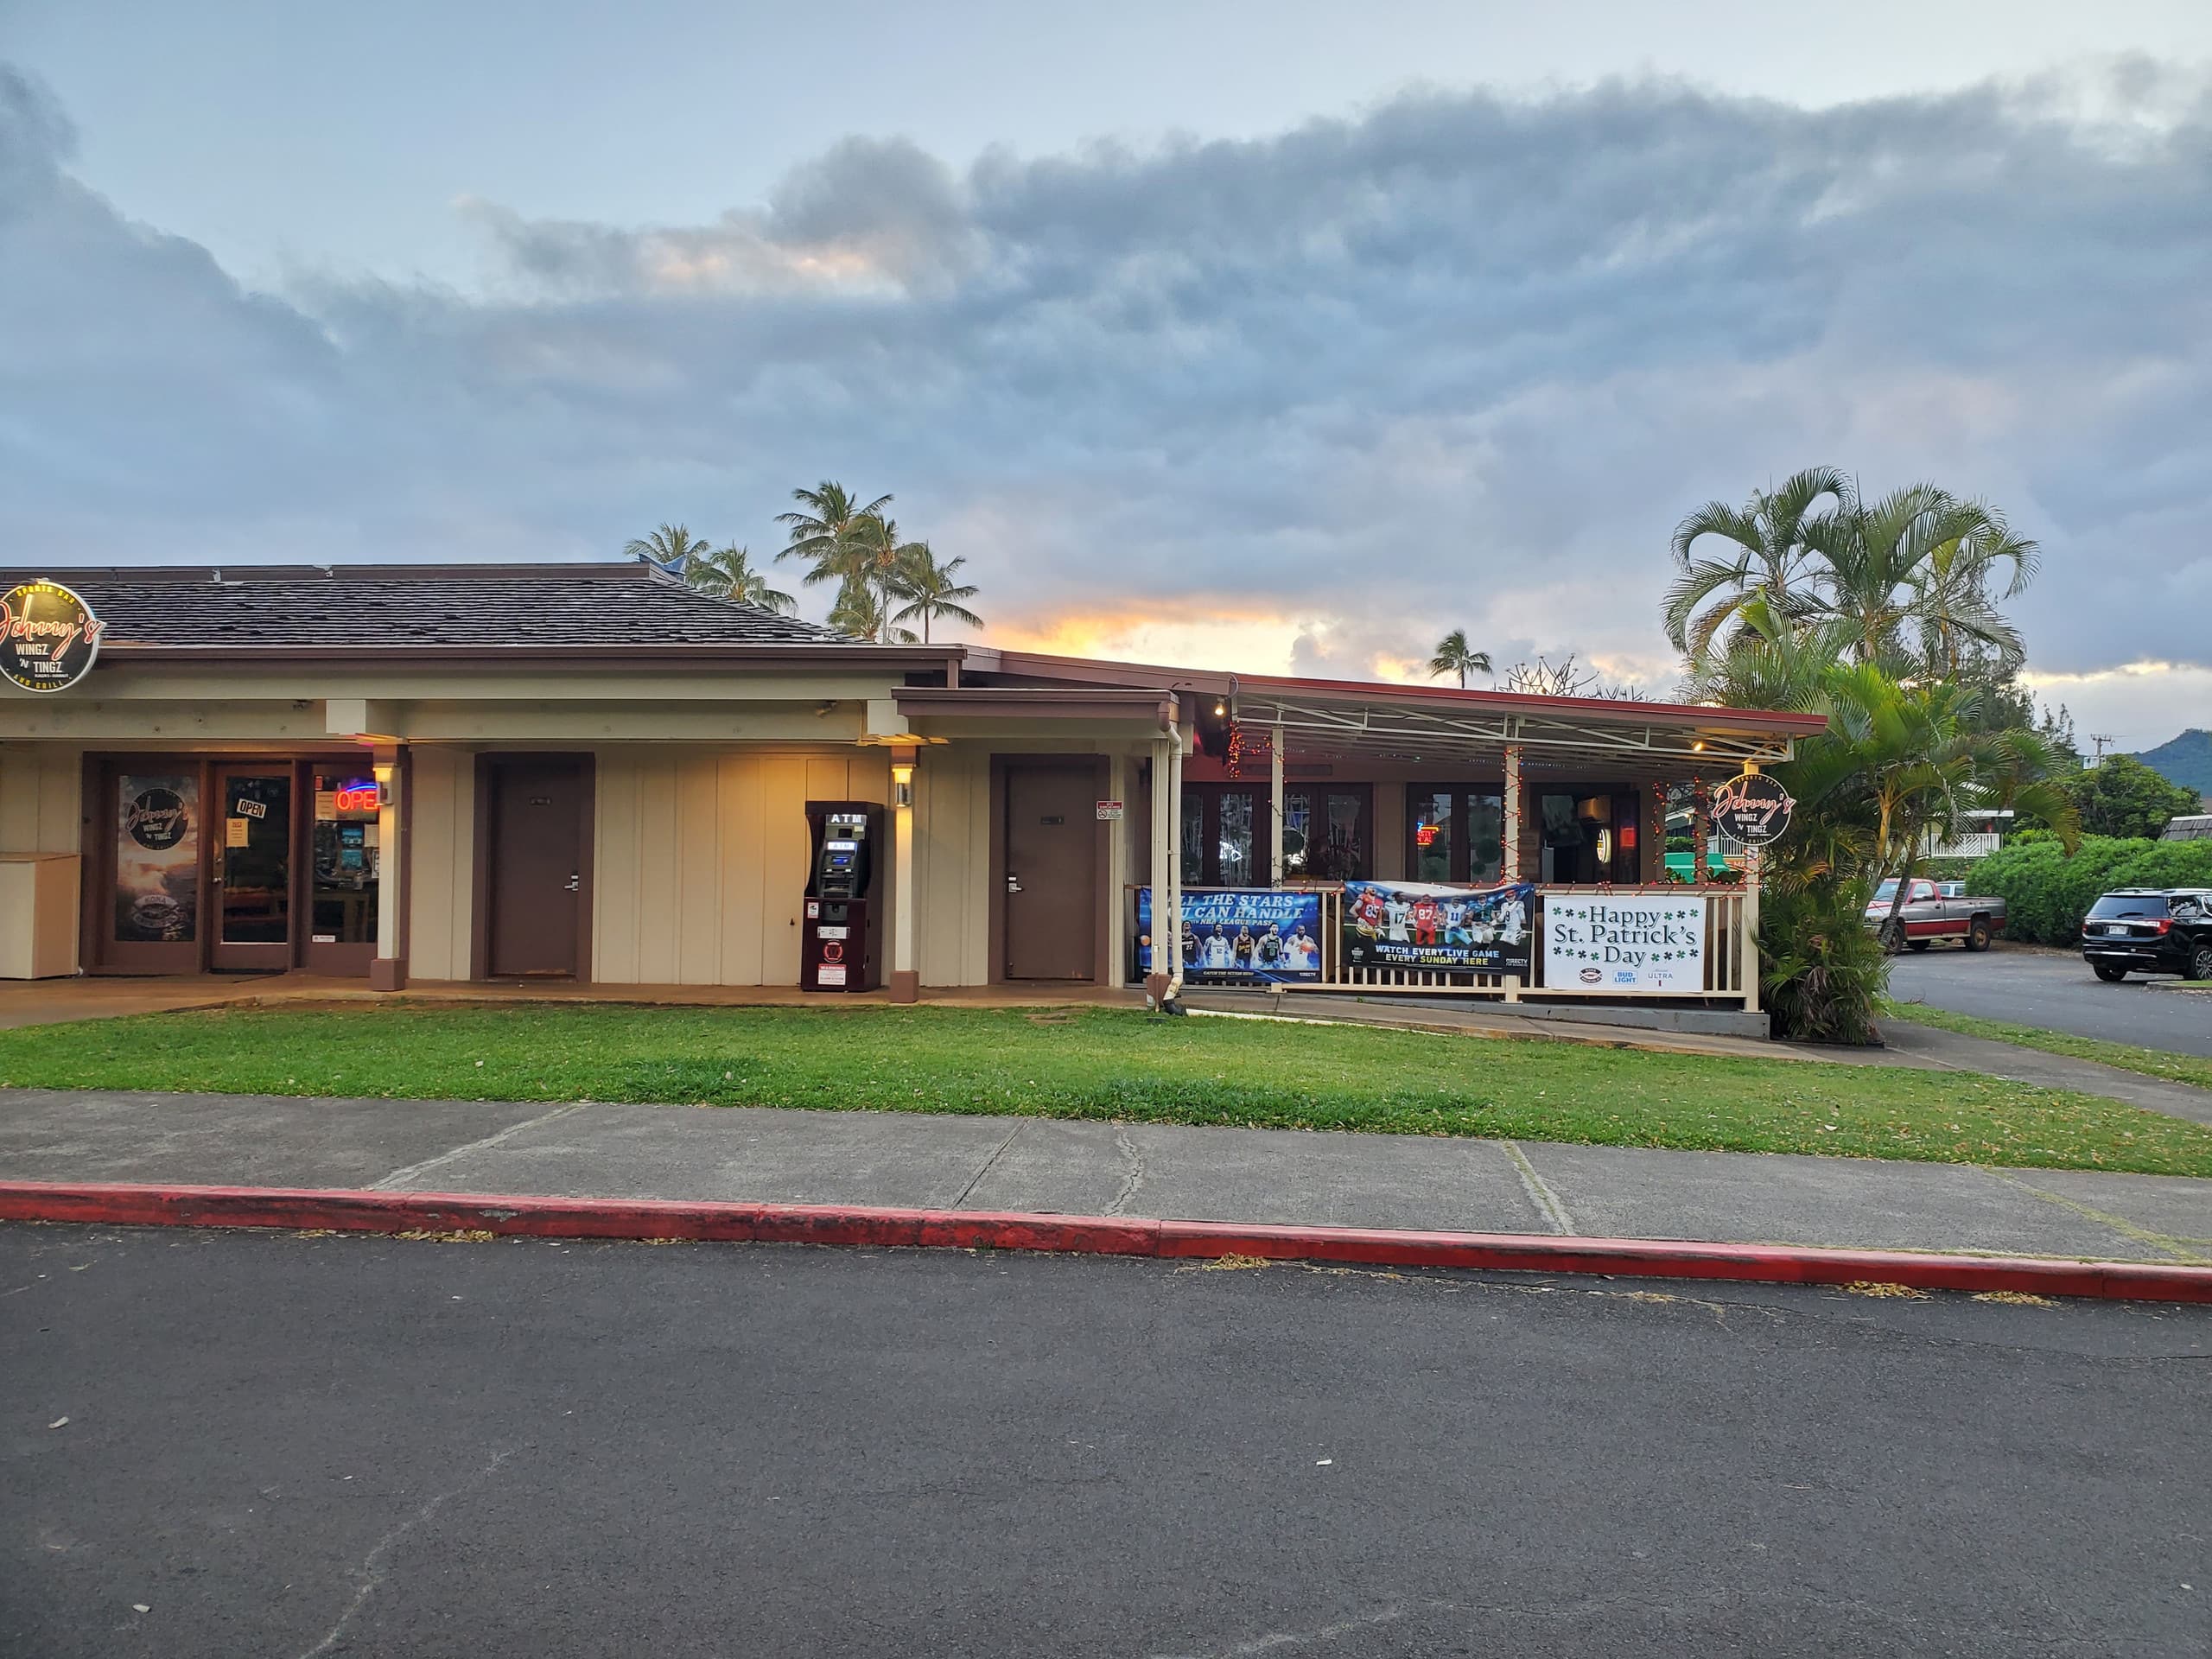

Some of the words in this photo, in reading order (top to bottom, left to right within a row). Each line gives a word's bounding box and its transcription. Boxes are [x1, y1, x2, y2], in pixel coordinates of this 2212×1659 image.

[16, 585, 54, 598] SPORTS
[57, 589, 76, 605] BAR
[16, 643, 49, 656] WINGZ
[33, 661, 63, 673] TINGZ
[13, 674, 31, 686] AND
[35, 680, 65, 690] GRILL
[336, 790, 379, 810] OPE
[1713, 781, 1796, 825] Johnny's
[125, 795, 189, 832] Johnny's
[239, 800, 264, 817] OPEN
[830, 814, 862, 823] ATM
[1734, 813, 1758, 822] WINGZ
[1746, 825, 1768, 834] TINGZ
[1203, 893, 1236, 906] THE
[1238, 895, 1294, 907] STARS
[1194, 906, 1232, 918] CAN
[1234, 906, 1304, 919] HANDLE
[1365, 904, 1381, 918] 85
[1395, 912, 1406, 924] 17
[1418, 909, 1433, 919] 87
[1450, 912, 1459, 921] 11
[1480, 911, 1484, 919] 1
[1589, 906, 1661, 928] Happy
[1554, 924, 1584, 944] St.
[1590, 924, 1697, 945] Patrick's
[1376, 944, 1408, 954] WATCH
[1412, 947, 1444, 956] EVERY
[1471, 950, 1500, 958] GAME
[1604, 946, 1647, 969] Day
[1385, 953, 1416, 963] EVERY
[1420, 956, 1458, 964] SUNDAY
